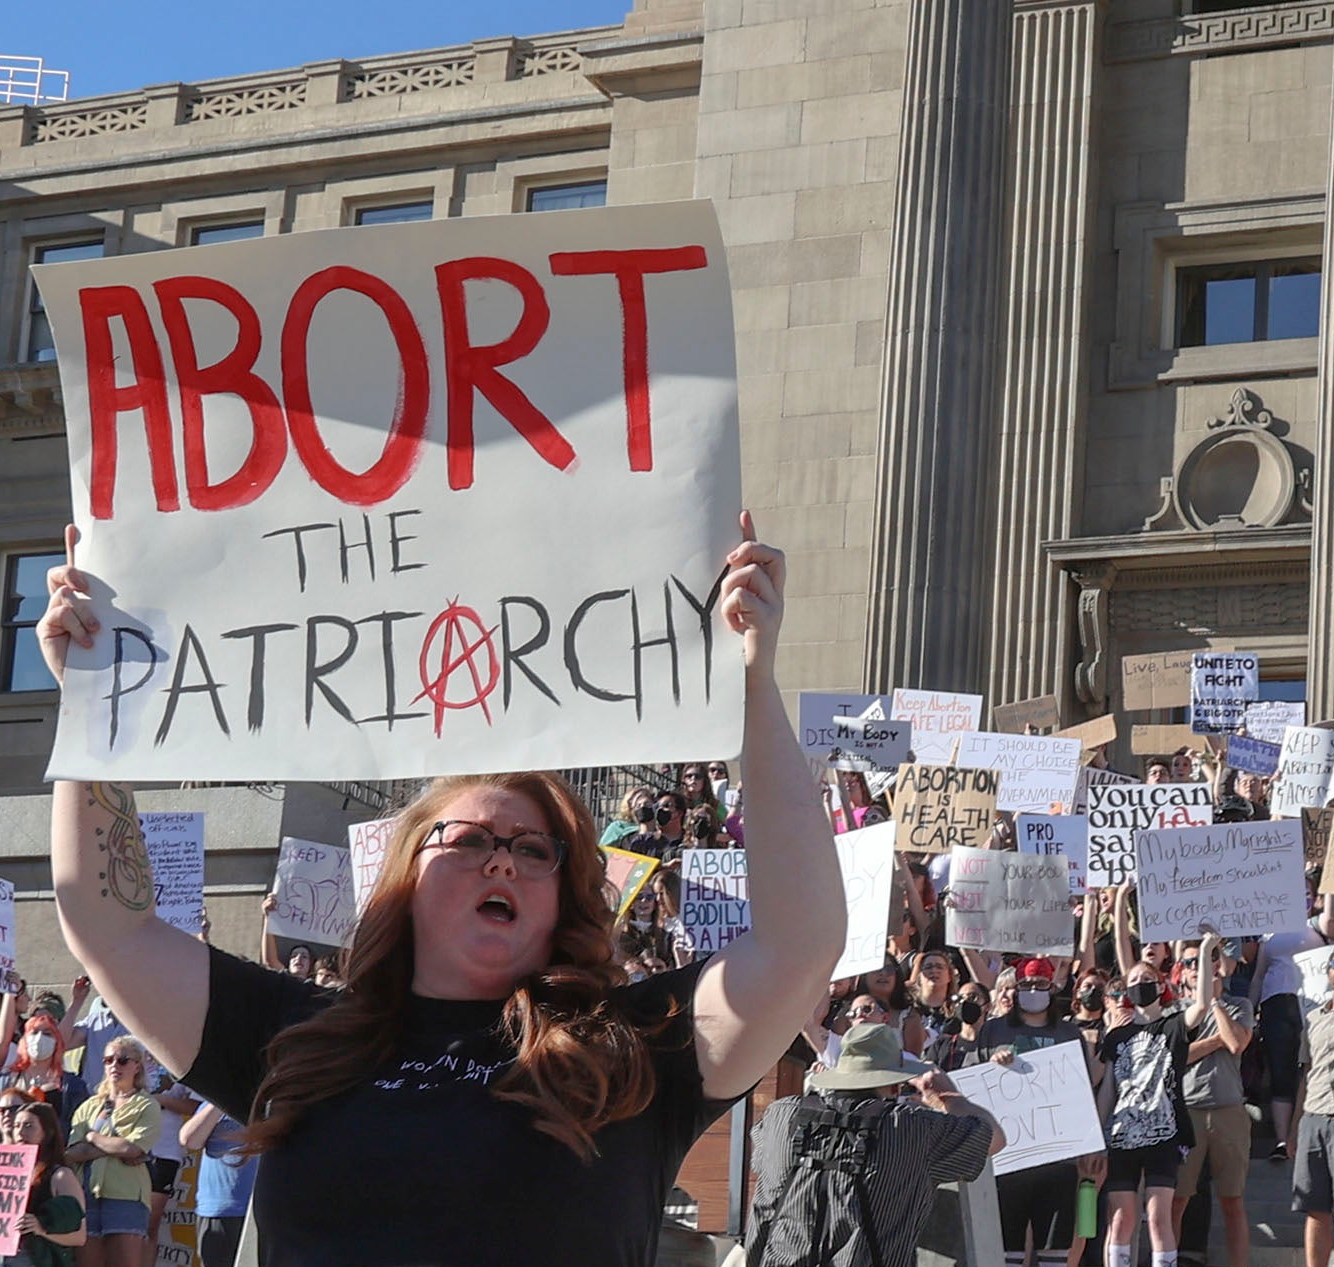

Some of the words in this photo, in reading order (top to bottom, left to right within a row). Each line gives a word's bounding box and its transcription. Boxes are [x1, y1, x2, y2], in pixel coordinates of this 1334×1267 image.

[79, 245, 708, 521] ABORT
[262, 509, 424, 593] THE
[102, 562, 735, 752] PATRIARCHY
[1194, 658, 1234, 670] UNITE
[1235, 658, 1255, 670] TO
[1204, 675, 1246, 687] FIGHT
[895, 693, 926, 712] Keep
[928, 695, 972, 712] Abortion
[862, 723, 899, 742] BODY
[938, 714, 976, 733] LEGAL
[970, 738, 989, 752] IT
[998, 738, 1048, 753] SHOULD
[1052, 742, 1074, 754] BE
[1285, 732, 1321, 756] KEEP
[989, 754, 1020, 769] MY
[1027, 756, 1078, 770] CHOICE
[899, 765, 1000, 796] ABORTION
[937, 794, 951, 806] IS
[1150, 787, 1214, 806] can
[901, 803, 990, 830] HEALTH
[1089, 805, 1158, 829] only
[909, 826, 978, 849] CARE
[1026, 823, 1055, 841] PRO
[286, 847, 328, 864] KEEP
[1139, 832, 1178, 868] My
[957, 858, 990, 876] NOT
[1001, 862, 1035, 880] YOUR
[685, 875, 750, 902] HEALT
[1140, 873, 1167, 897] My
[1171, 867, 1224, 891] freedom
[955, 892, 988, 908] NOT
[1003, 897, 1036, 912] YOUR
[683, 901, 746, 927] BODILY
[1142, 906, 1163, 929] be
[700, 927, 714, 949] A
[954, 927, 985, 943] NOT
[998, 930, 1027, 945] YOUR
[956, 1053, 1087, 1112] EFORM
[998, 1103, 1064, 1147] OVT.
